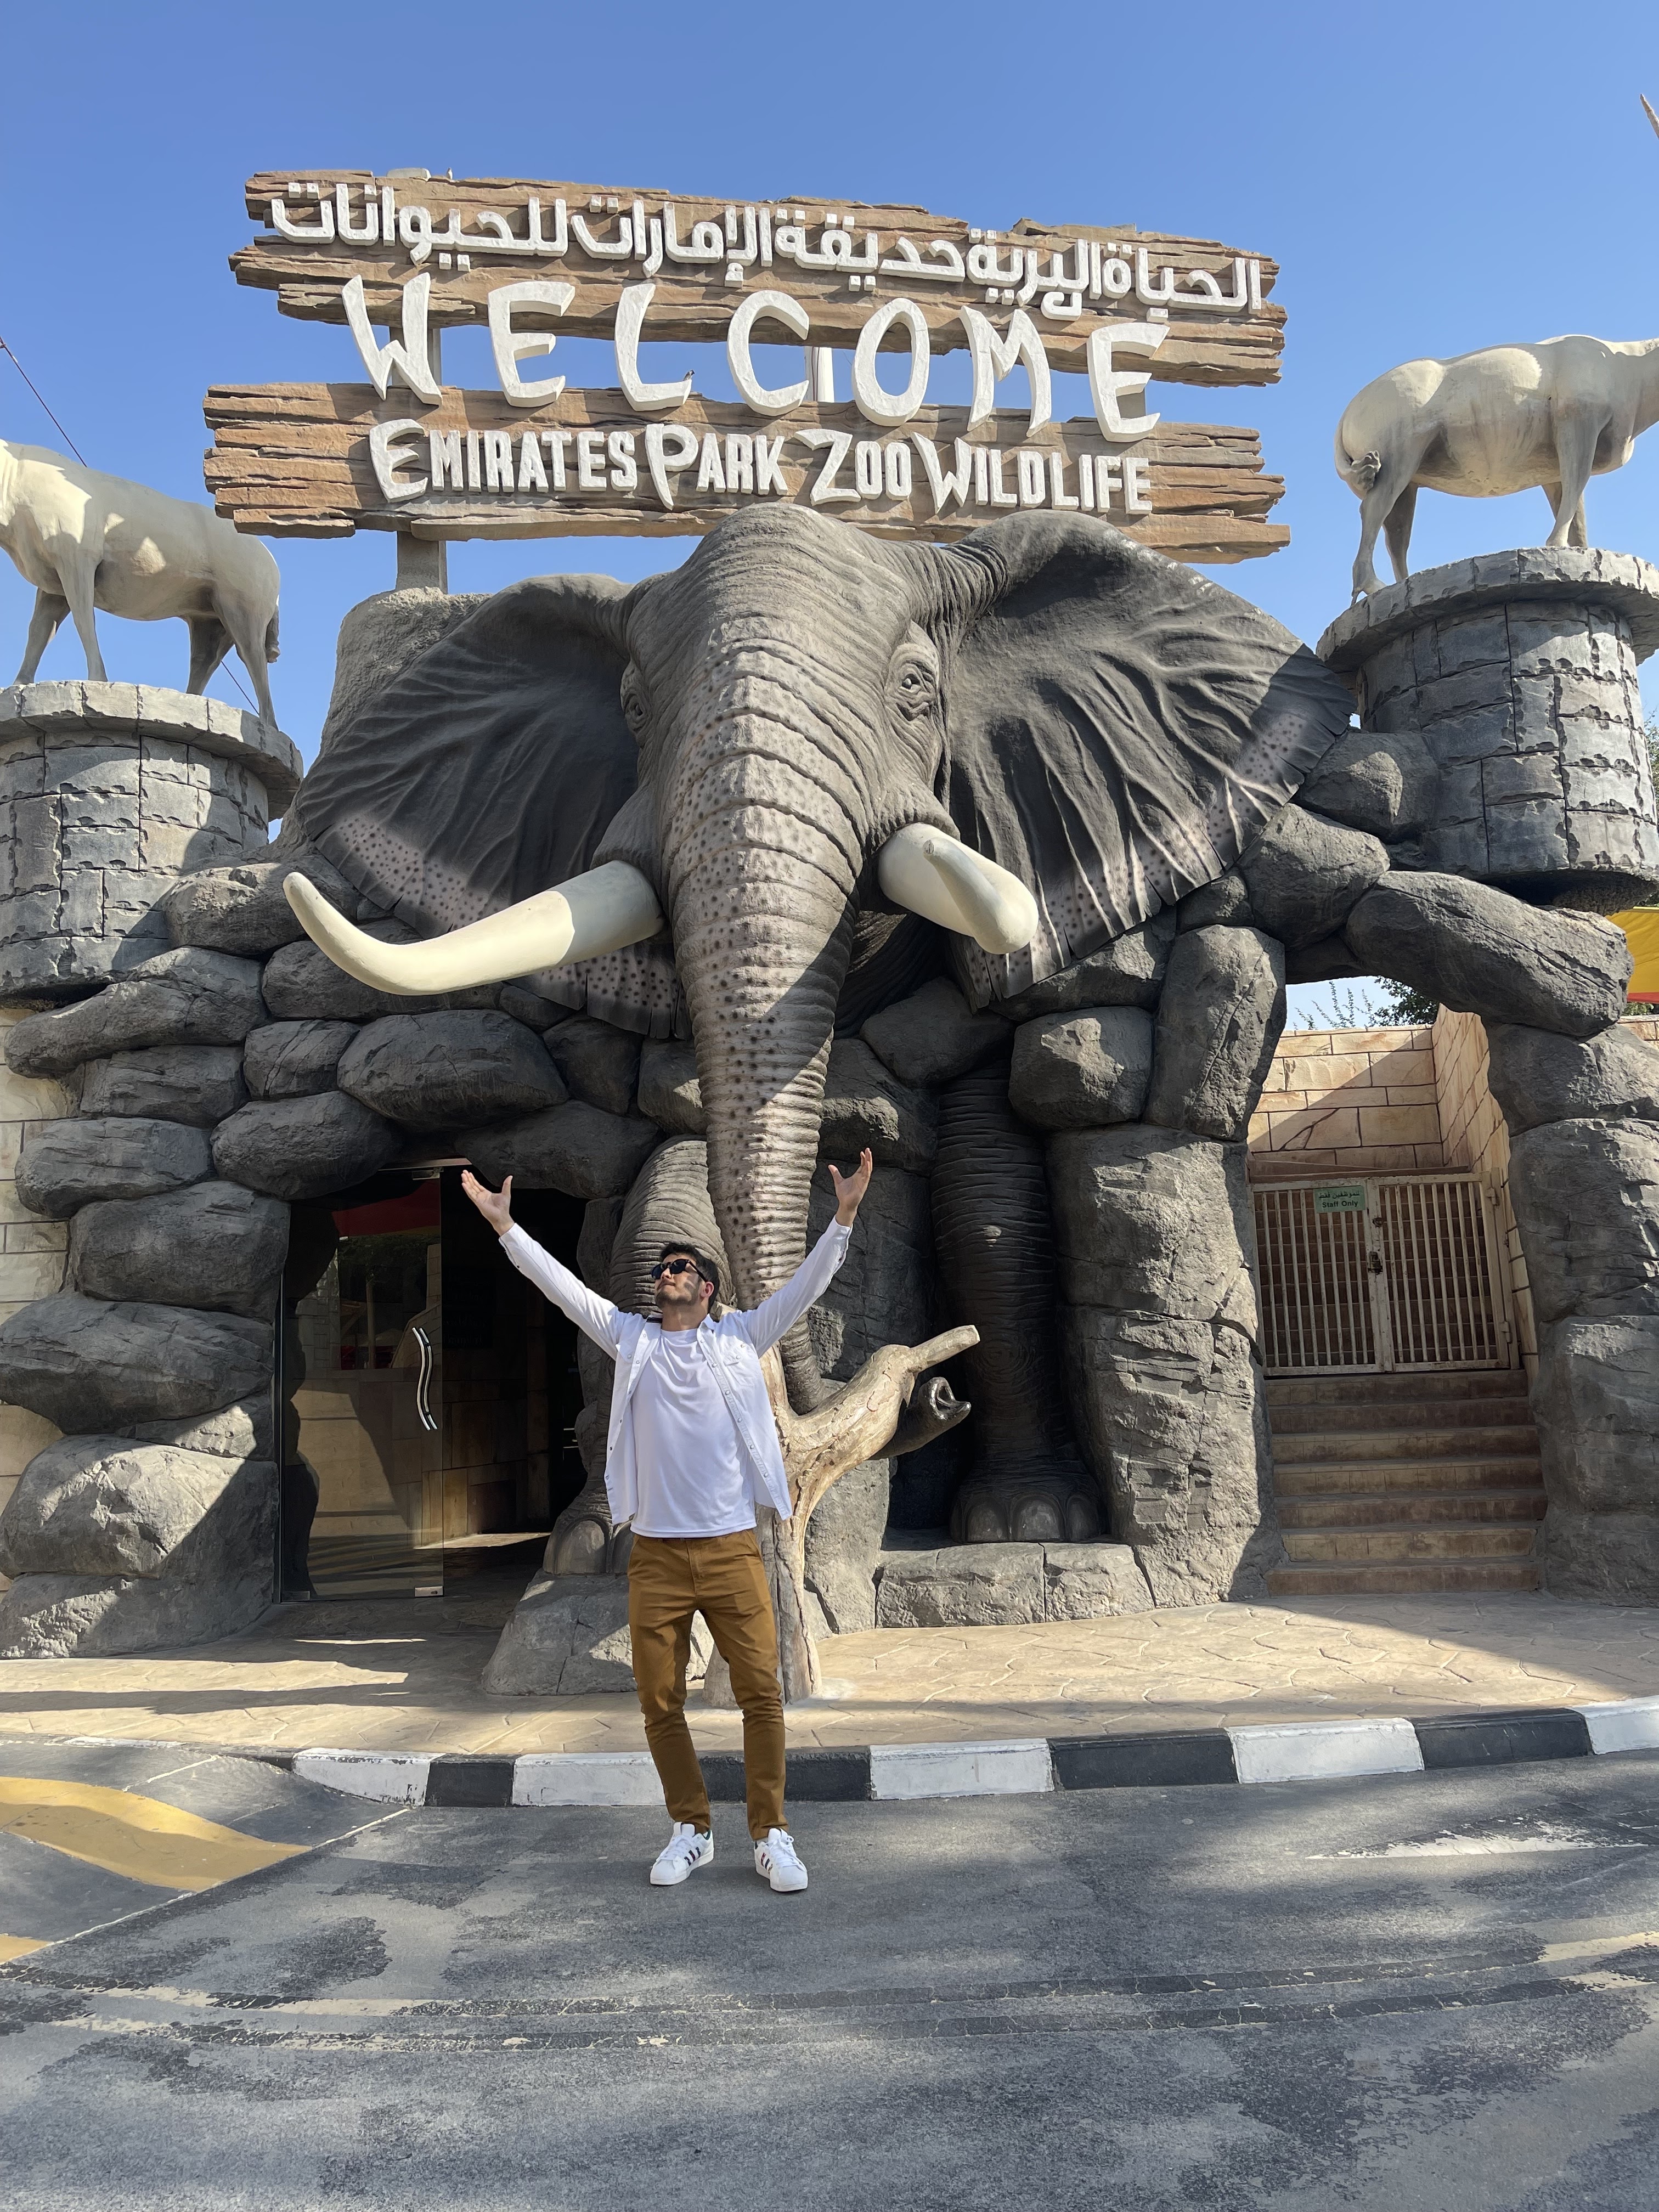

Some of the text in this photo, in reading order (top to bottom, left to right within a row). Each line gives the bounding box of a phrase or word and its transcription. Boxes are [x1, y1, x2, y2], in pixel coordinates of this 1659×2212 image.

[271, 182, 568, 272] للحيوانات
[571, 195, 773, 288] الإمارات
[775, 208, 966, 292] حديقة
[1102, 242, 1261, 323] الحياة
[341, 272, 1170, 443] WELCOME
[369, 419, 1153, 515] EMIRATES PARK ZOO WILDLIFE
